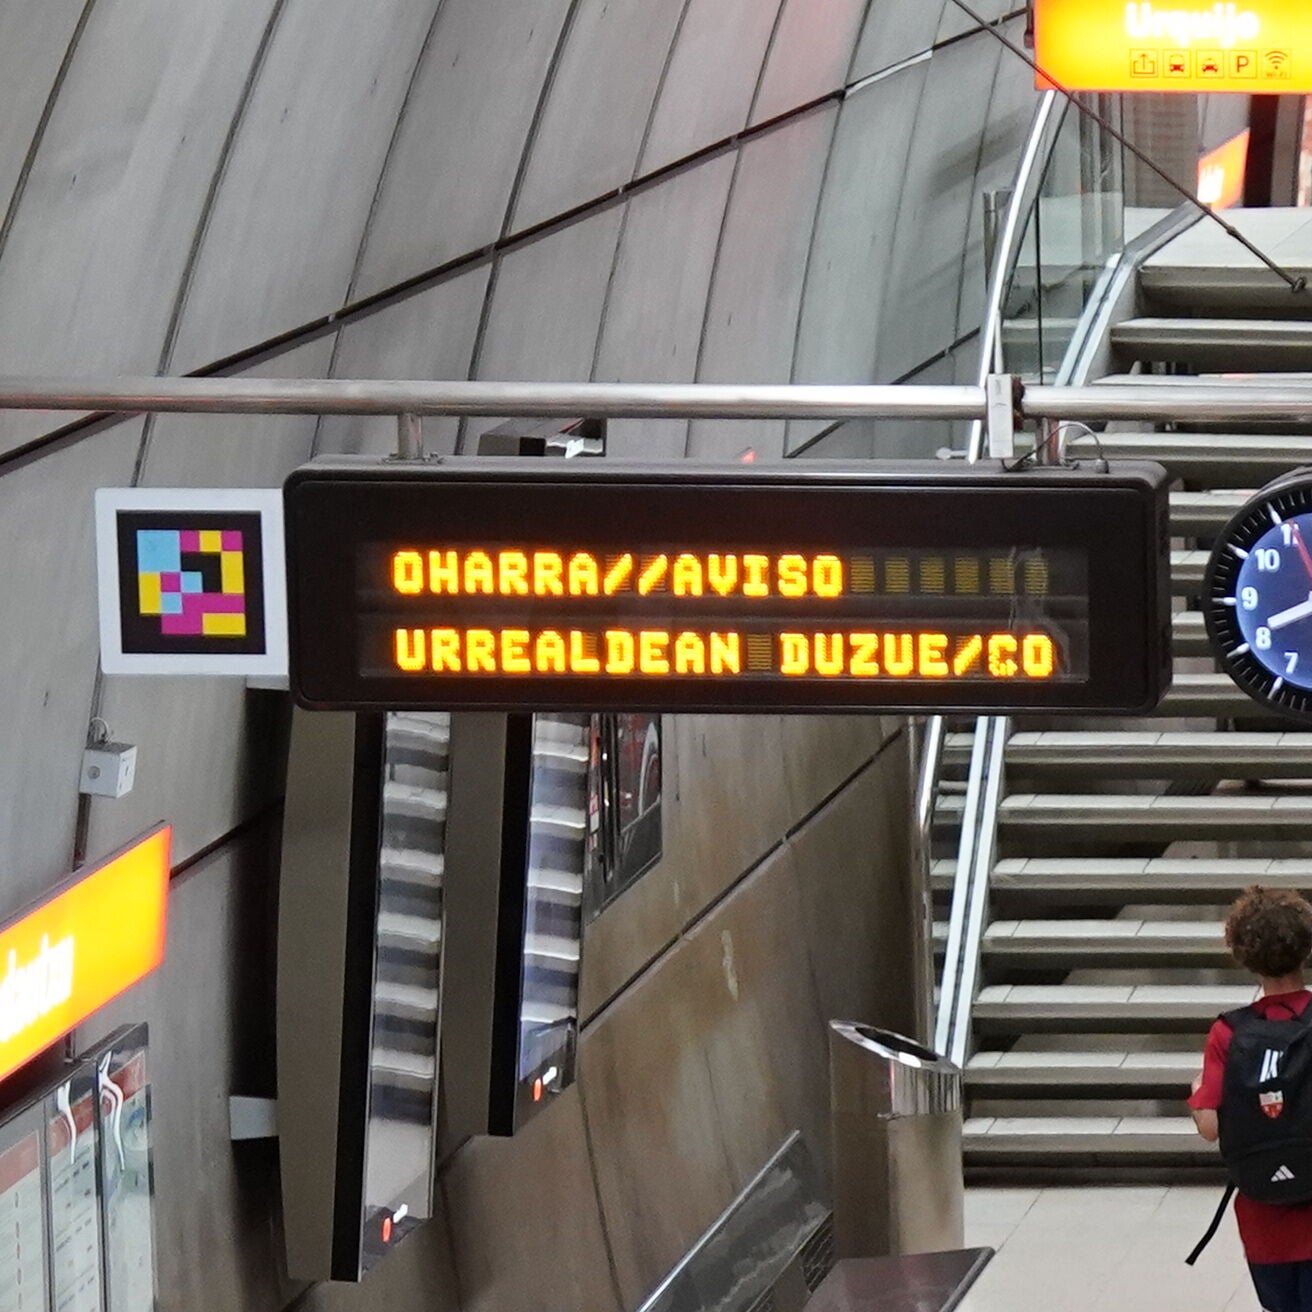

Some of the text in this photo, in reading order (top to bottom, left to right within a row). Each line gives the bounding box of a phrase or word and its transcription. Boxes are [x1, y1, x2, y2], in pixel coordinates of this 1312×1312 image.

[1255, 548, 1281, 572] 10
[394, 550, 843, 597] OHARRA//AVISO
[1241, 587, 1258, 610] 9
[1255, 627, 1272, 649] 8
[396, 628, 1053, 677] URREALDEAN DUZUE/CO
[1284, 652, 1298, 674] 7
